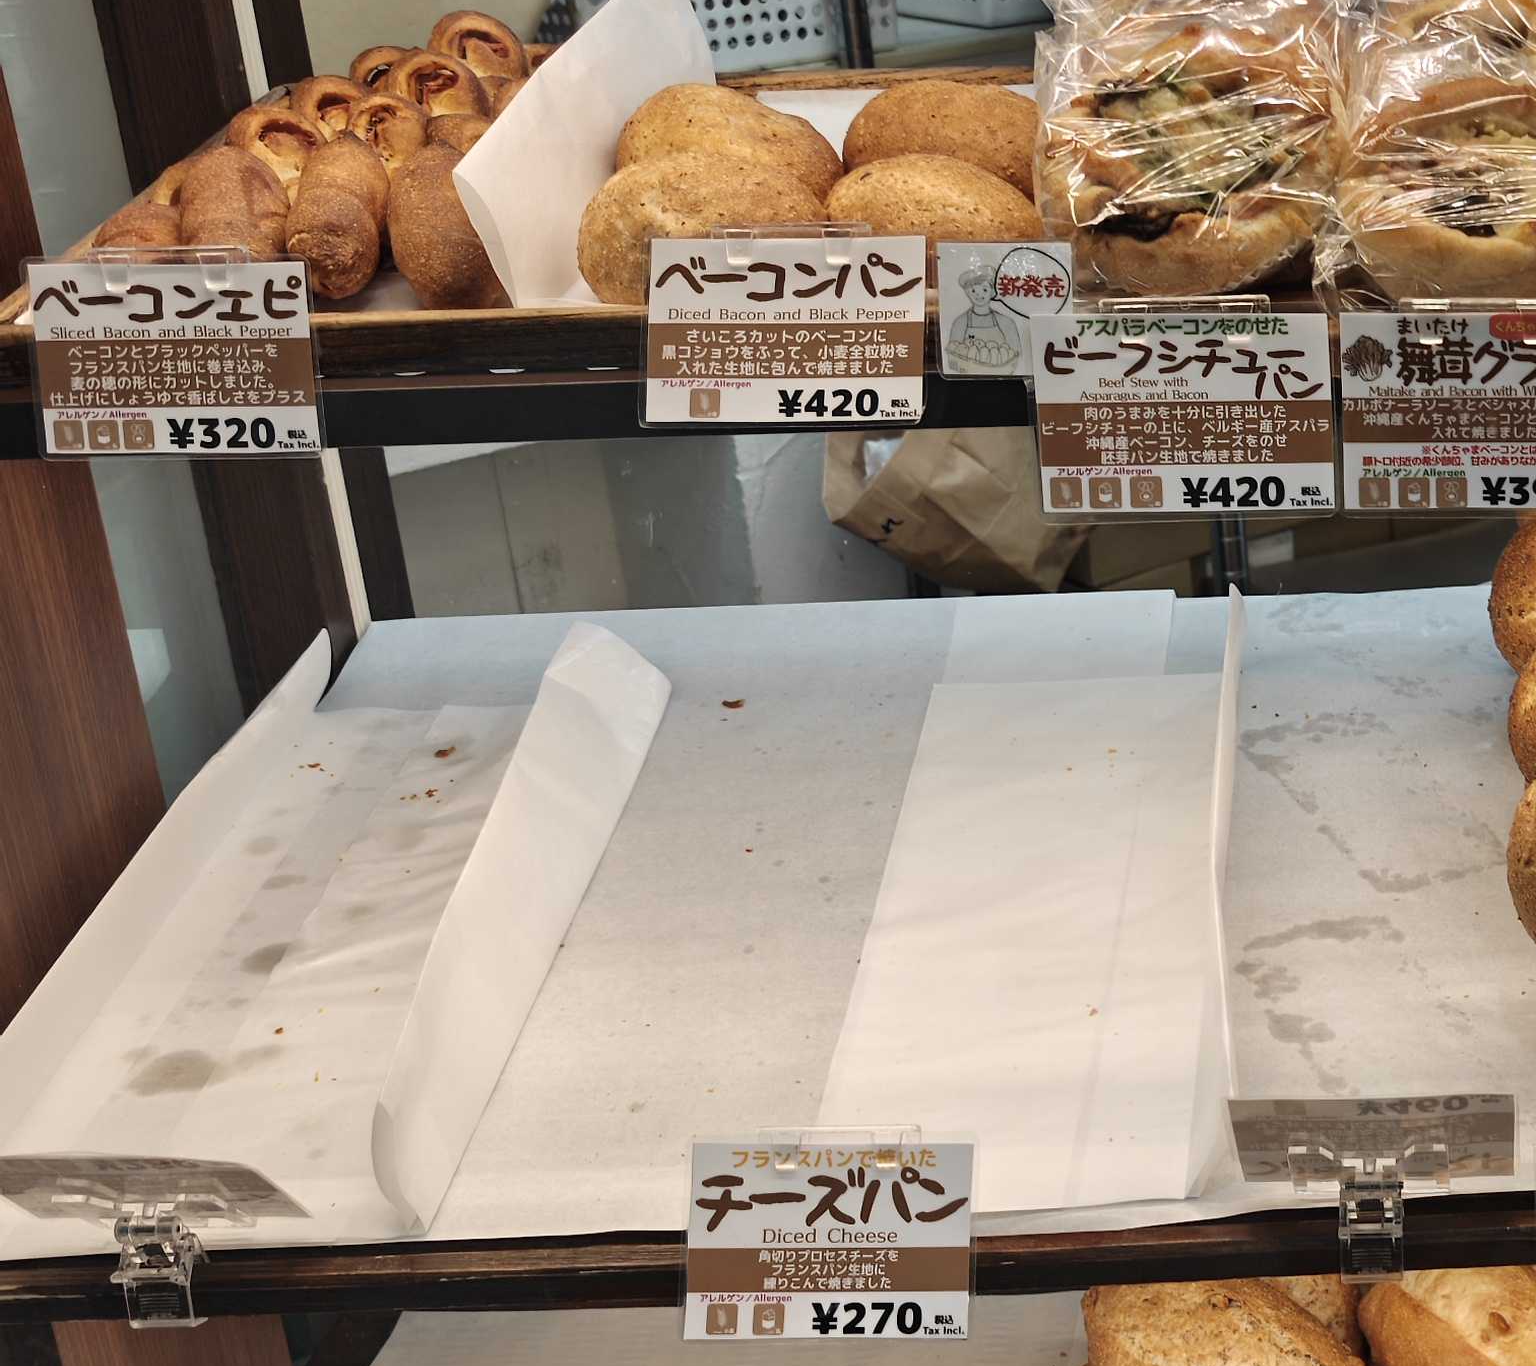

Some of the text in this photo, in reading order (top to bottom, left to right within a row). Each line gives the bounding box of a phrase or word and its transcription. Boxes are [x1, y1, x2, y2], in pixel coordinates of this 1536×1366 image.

[656, 252, 922, 301] ベーコンパン
[998, 274, 1066, 299] 新発売
[34, 275, 302, 322] ベーコンエピ
[668, 308, 910, 322] Diced Bacon and Black Pepper
[1397, 317, 1469, 335] まいたけ
[687, 328, 887, 344] さいころカットのベーコンに
[1076, 317, 1289, 336] アスパラベーコンをのせた
[69, 344, 278, 358] ベーコンとブラックペッパーを
[1044, 337, 1305, 377] ビーフシチュー
[677, 360, 894, 376] 入れた生地に包んで焼きました
[1256, 363, 1324, 399] パン
[778, 389, 879, 418] ¥420
[1084, 405, 1287, 421] 肉のうまみを十分に引き出した
[167, 418, 275, 448] ¥320
[1182, 476, 1285, 507] ¥420
[696, 1167, 968, 1232] チーズパン
[762, 1228, 898, 1244] Diced Cheese
[759, 1250, 898, 1263] 角切りプロセスチーズを
[771, 1263, 886, 1276] フランスパン生地に
[812, 1301, 922, 1335] ¥270
